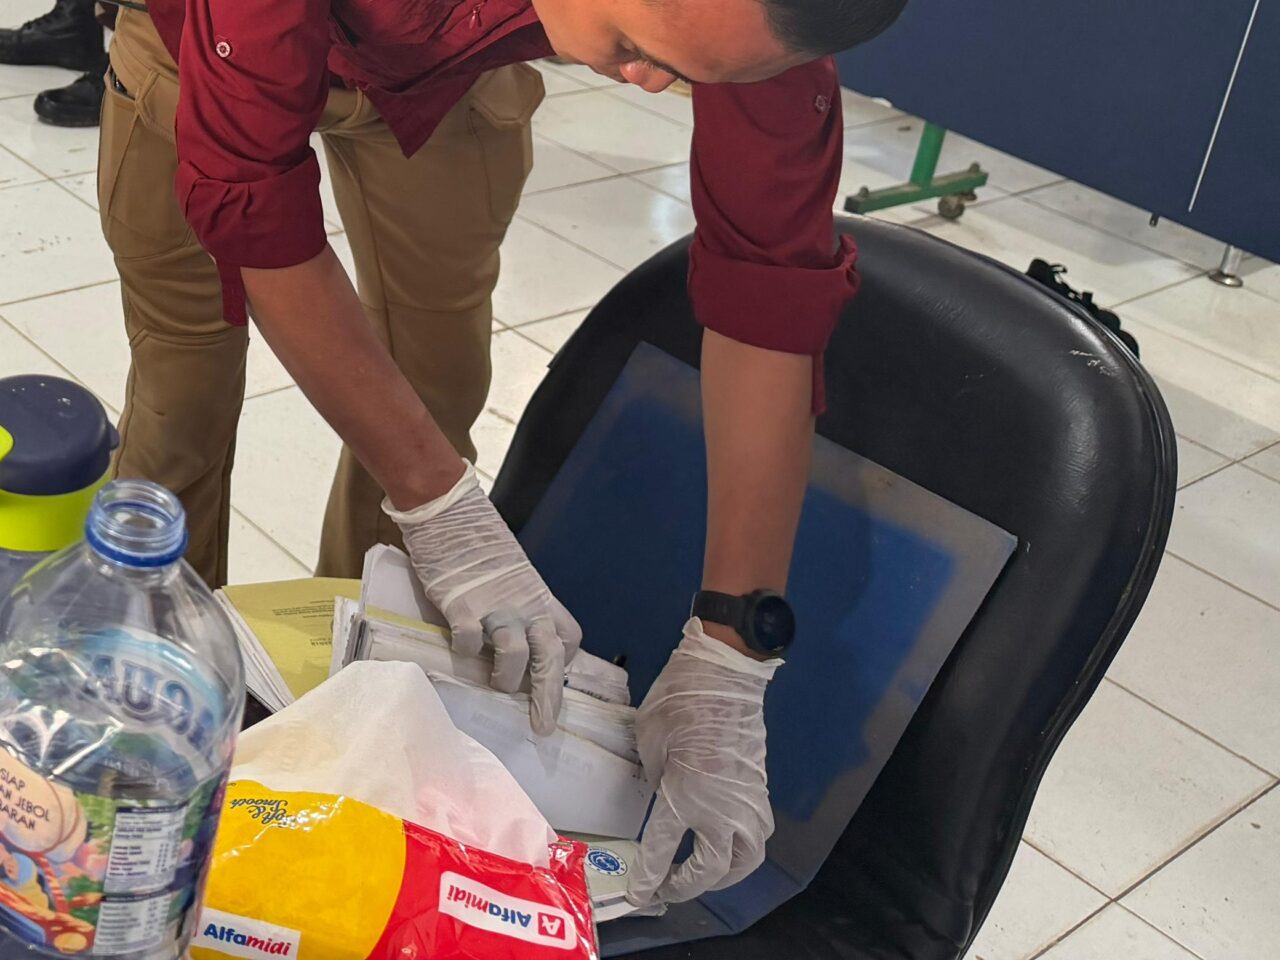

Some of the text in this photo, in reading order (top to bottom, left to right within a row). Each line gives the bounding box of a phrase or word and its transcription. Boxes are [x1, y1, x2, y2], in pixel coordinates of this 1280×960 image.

[16, 796, 50, 822] JEBOL
[447, 884, 532, 928] Alfamidi
[204, 923, 292, 956] Alfamidi
